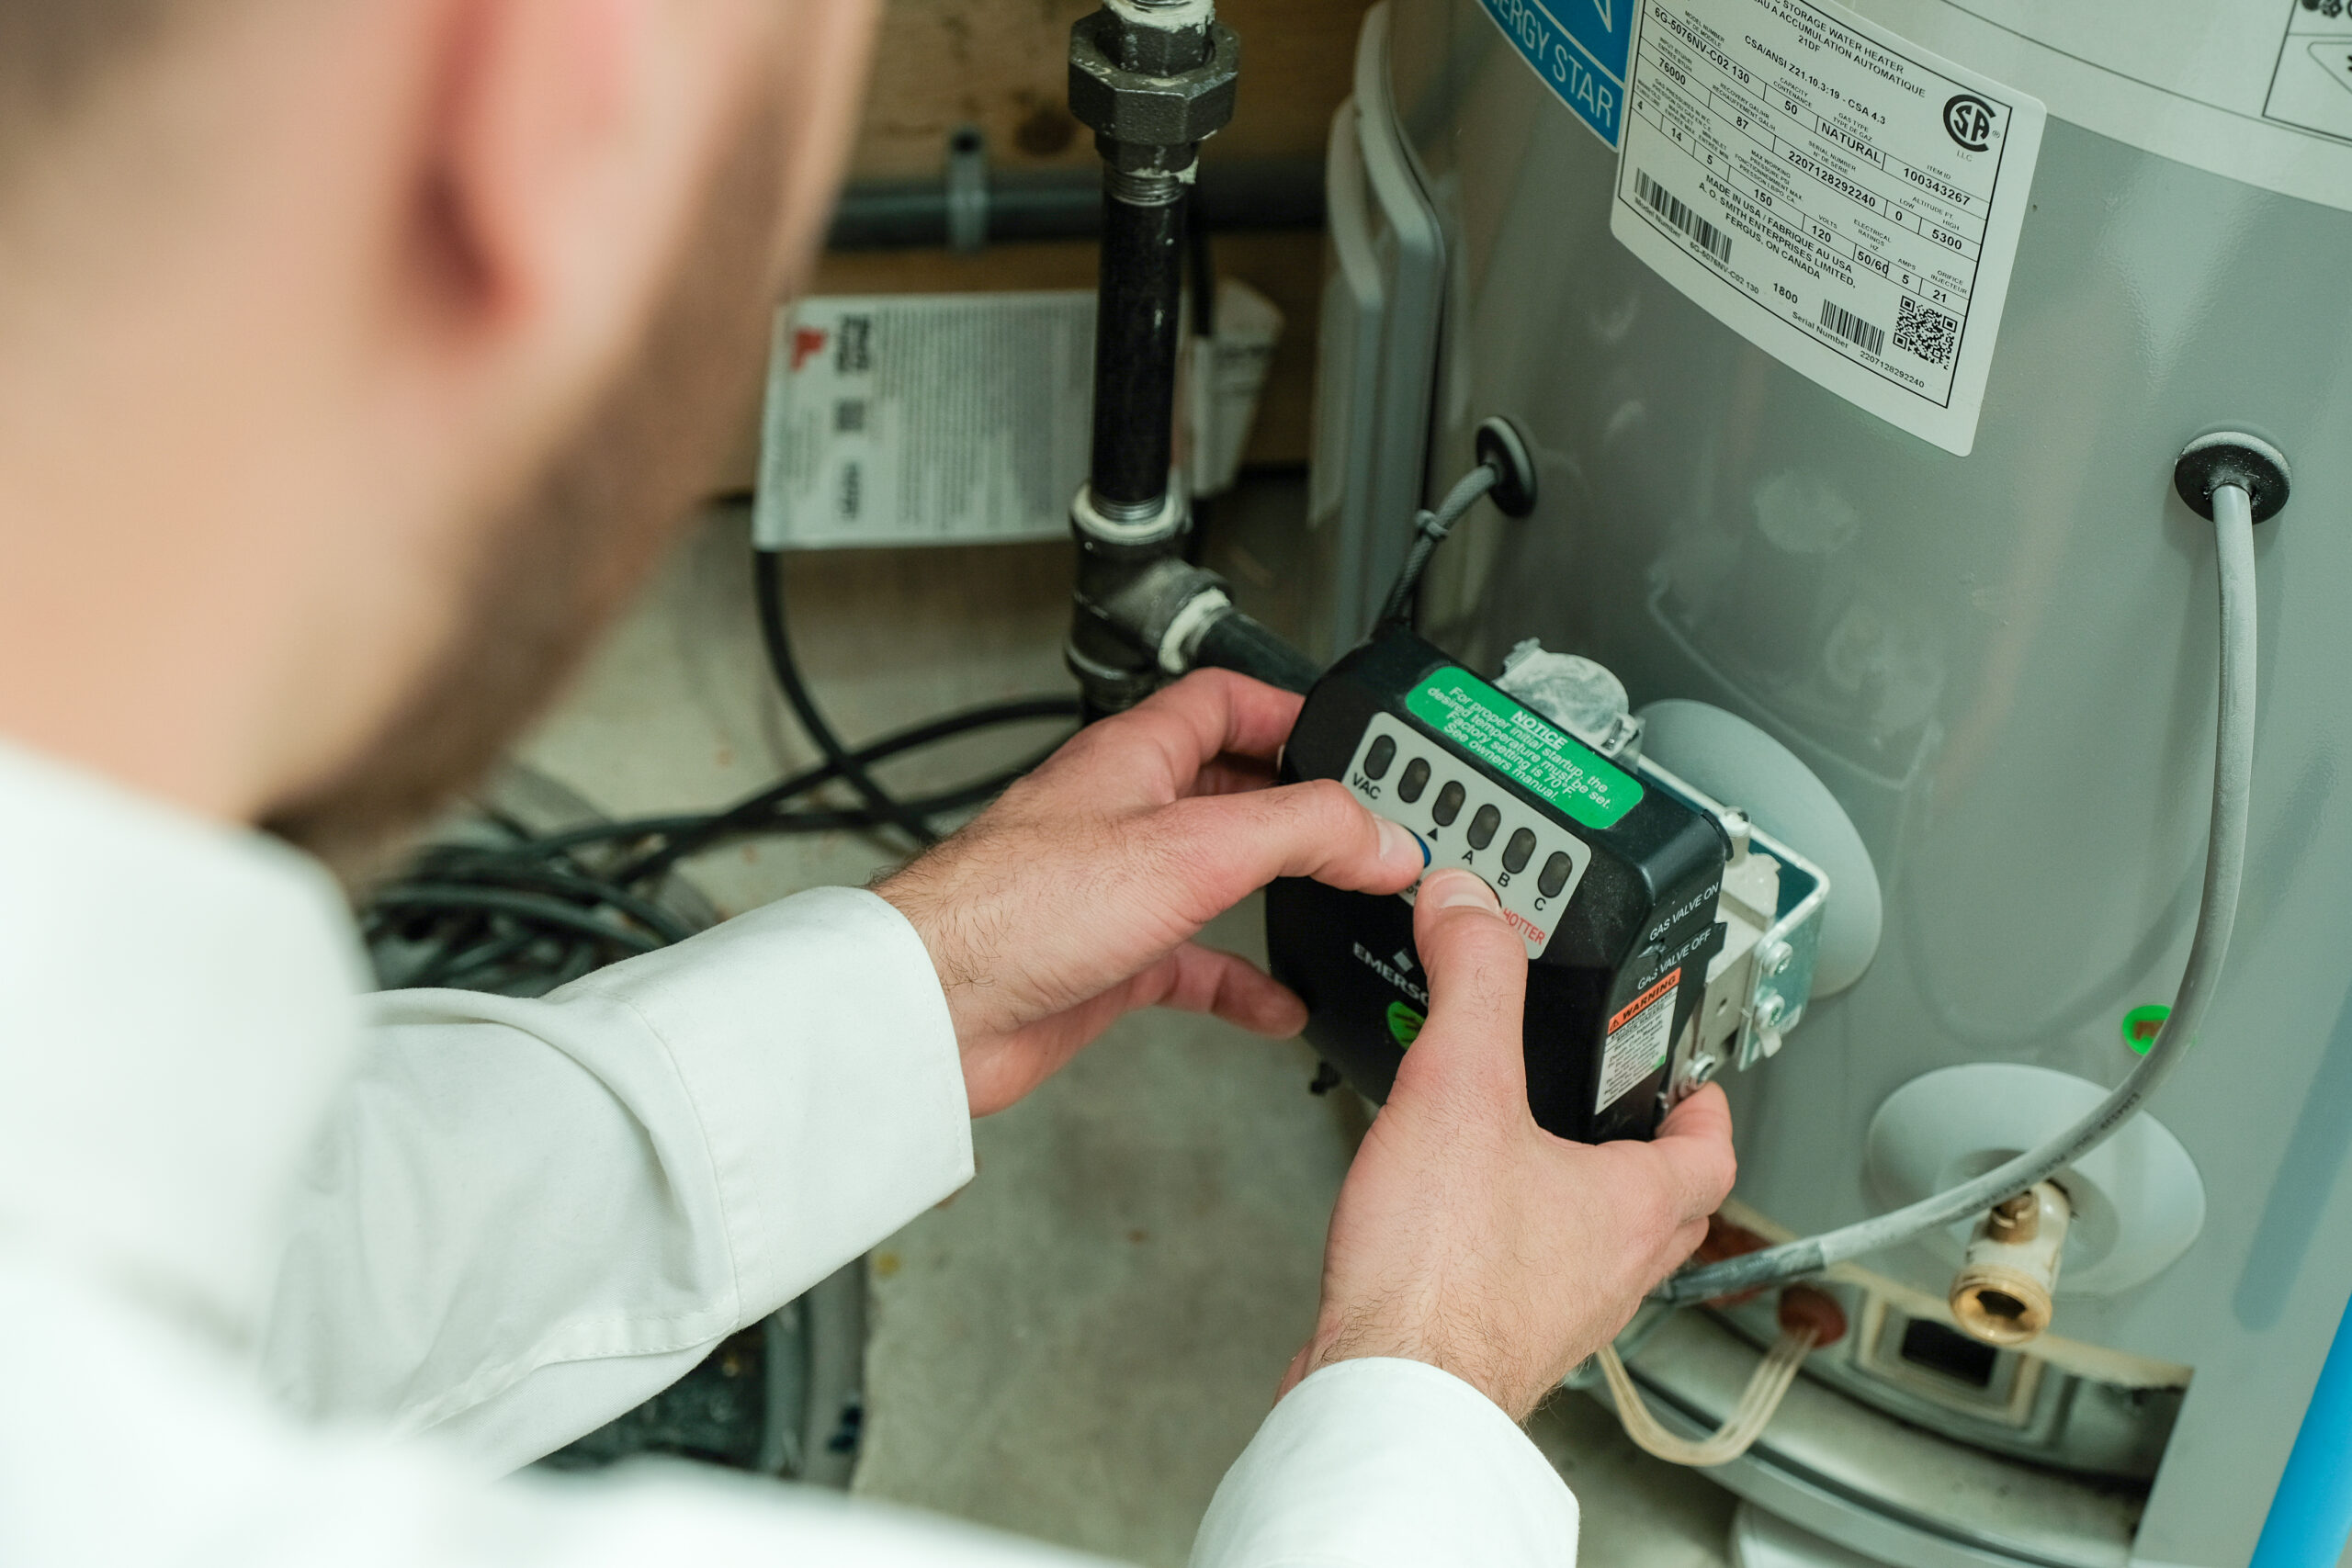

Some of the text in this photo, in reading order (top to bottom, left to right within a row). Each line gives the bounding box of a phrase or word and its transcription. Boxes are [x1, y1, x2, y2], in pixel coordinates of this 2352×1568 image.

[1685, 10, 1725, 43] MODEL NUMBER
[1783, 0, 1905, 74] STORAGE WATER HEATER
[1655, 7, 1749, 84] 6G-5076NV-C02 130
[1753, 0, 1927, 98] AU A ACCUMULATION AUTOMATIQUE
[1798, 35, 1820, 52] 21DF
[1659, 58, 1686, 85] 76000
[1745, 35, 1787, 69] CSA/ANSI
[1789, 63, 1839, 99] Z21.10.3:19
[1848, 99, 1869, 117] CSA
[1871, 111, 1885, 125] 4.3
[1553, 44, 1612, 127] STAR
[1720, 83, 1748, 105] RECOVERY
[1773, 81, 1813, 108] CONTENANCE
[1780, 77, 1808, 97] CAPACITY
[1637, 100, 1643, 110] 4
[1784, 100, 1798, 115] 50
[1736, 117, 1748, 130] 87
[1833, 117, 1873, 142] TYPE DE GAZ
[1838, 112, 1869, 133] GAS TYPE
[1672, 128, 1682, 141] 14
[1821, 122, 1882, 164] NATURAL
[1707, 154, 1713, 164] 5
[1750, 156, 1780, 178] PRESSURE
[1751, 150, 1792, 178] MAX WORKING
[1808, 141, 1856, 171] SERIAL NUMBER
[1821, 155, 1829, 164] DE
[1788, 151, 1876, 208] 2207128292240
[1927, 164, 1943, 176] ITEM
[1754, 188, 1772, 207] 150
[1903, 167, 1971, 206] 100343267
[1899, 198, 1915, 209] LOW
[1912, 197, 1943, 215] ALTITUDE
[1699, 182, 1708, 194] A.
[1709, 188, 1717, 201] O.
[1720, 197, 1747, 220] SMITH
[1748, 215, 1813, 262] ENTERPRISES
[1705, 175, 1731, 197] MADE
[1732, 194, 1742, 205] IN
[1743, 201, 1761, 219] USA
[1768, 217, 1815, 252] FABRIQUE
[1815, 247, 1830, 261] AU
[1832, 255, 1852, 274] USA
[1818, 214, 1838, 229] VOLTS
[1895, 210, 1903, 221] 0
[1942, 219, 1960, 231] HIGH
[1812, 225, 1831, 243] 120
[1854, 219, 1892, 243] ELECTRICAL
[1858, 229, 1885, 246] RATINGS
[1931, 229, 1962, 250] 5300
[1765, 240, 1780, 254] ON
[1781, 250, 1820, 279] CANADA
[1857, 251, 1889, 275] 50/60
[1897, 258, 1917, 271] AMPS
[1746, 281, 1759, 294] 130
[1902, 275, 1909, 285] 5
[1930, 275, 1968, 295] INJECTEUR
[1937, 270, 1963, 286] ORIFICE
[1773, 283, 1798, 304] 1800
[1932, 289, 1947, 303] 21
[1792, 311, 1925, 389] Serial Number 2207128292240
[1427, 687, 1473, 717] desired
[1471, 714, 1541, 762] temperature
[1541, 760, 1572, 783] must
[1571, 778, 1589, 794] be
[1449, 687, 1474, 705] For
[1469, 702, 1511, 729] proper
[1510, 727, 1544, 750] initial
[1587, 775, 1608, 793] the
[1510, 710, 1568, 750] NOTICE
[1446, 709, 1492, 744] Factory
[1490, 740, 1531, 771] setting
[1530, 764, 1544, 778] is
[1443, 722, 1559, 802] See owners manual.
[1351, 773, 1382, 799] VAC
[1462, 850, 1474, 865] A
[1497, 872, 1511, 888] B
[1533, 897, 1547, 911] C
[1649, 882, 1719, 942] GAS VALVE ON
[1659, 943, 1690, 974] VALVE
[1690, 929, 1712, 951] OFF
[1622, 975, 1677, 1021] WARNING
